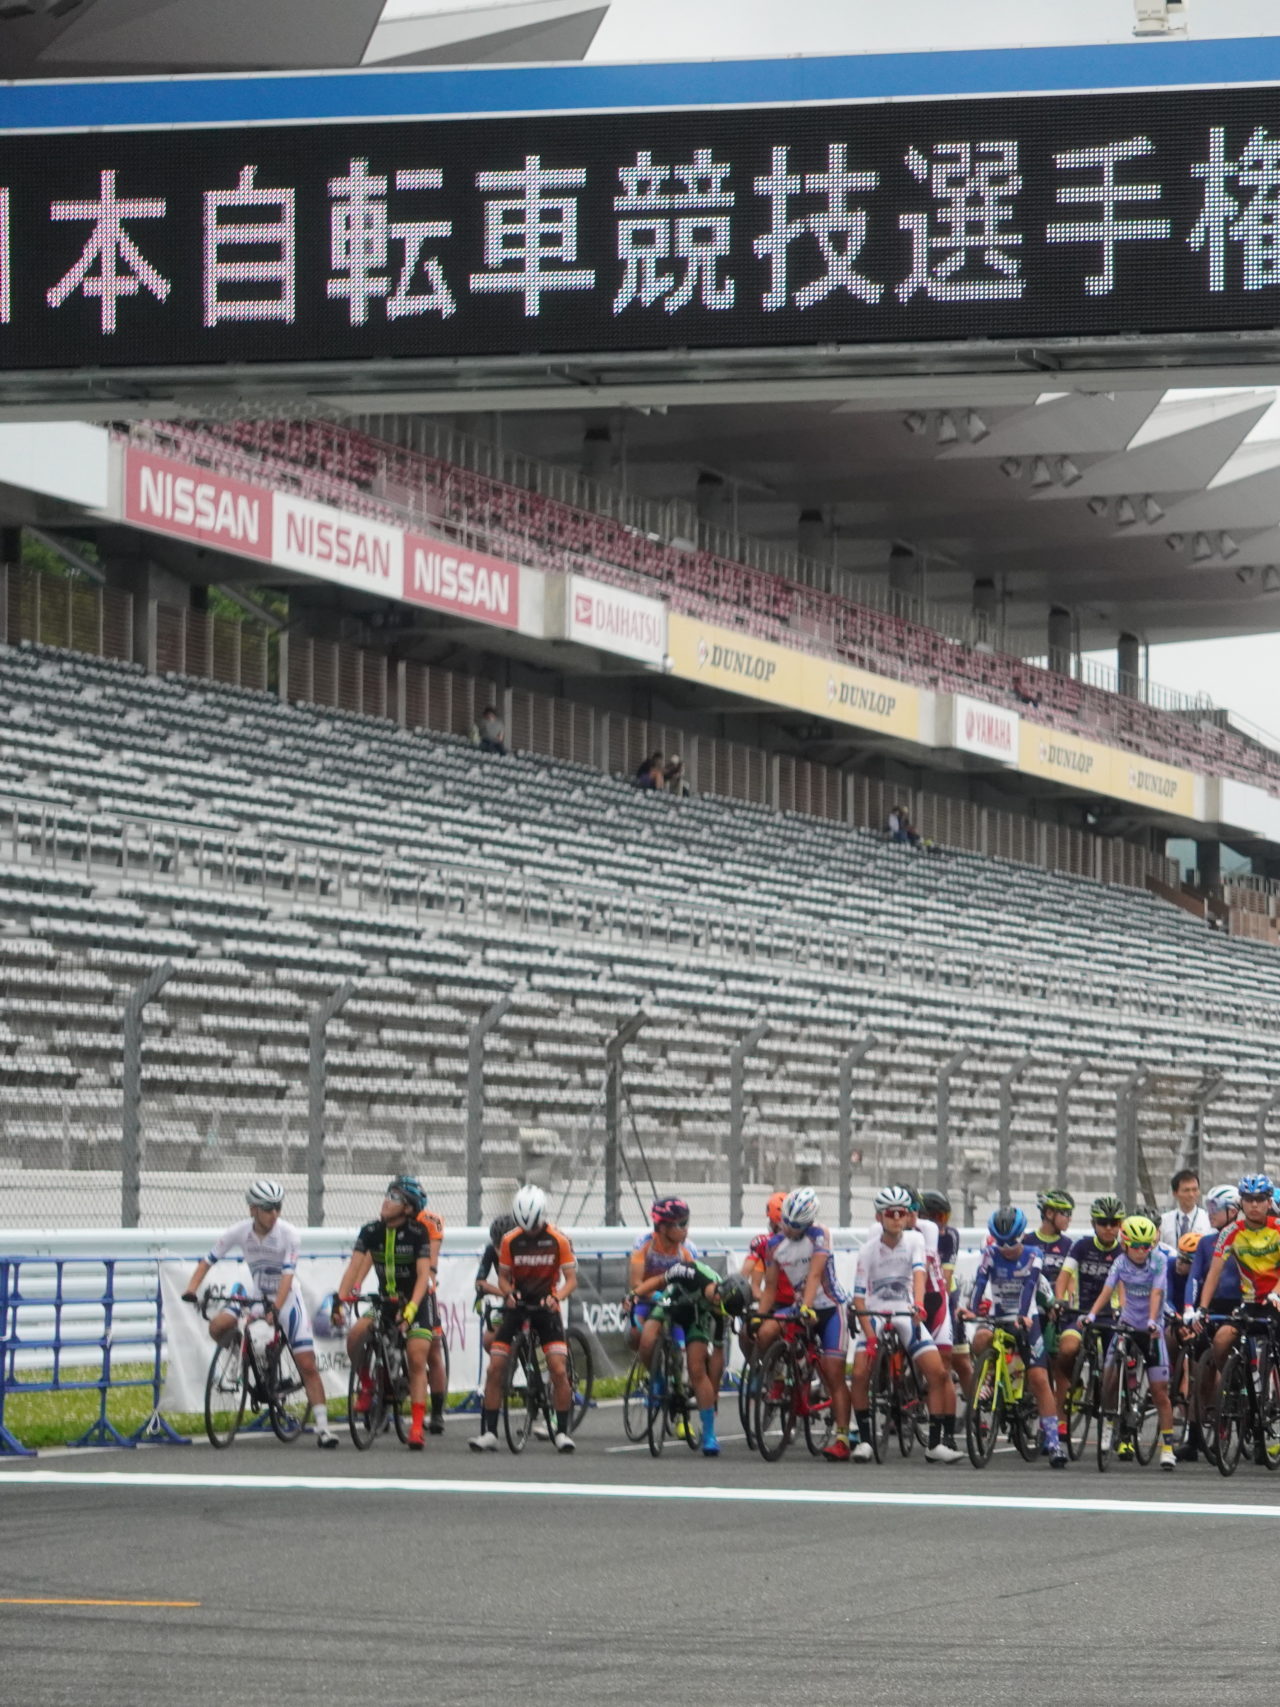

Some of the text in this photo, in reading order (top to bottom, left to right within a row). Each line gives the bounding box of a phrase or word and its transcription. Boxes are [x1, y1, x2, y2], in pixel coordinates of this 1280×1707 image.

[139, 465, 259, 545] NISSAN
[286, 515, 391, 580] NISSAN
[413, 548, 510, 615] NISSAN
[595, 607, 662, 648] DAIHATSU
[711, 644, 776, 683] DUNLOP
[839, 682, 896, 718] DUNLOP
[976, 711, 1012, 752] YAMAHA
[1047, 744, 1094, 776] DUNLOP
[1136, 770, 1178, 800] DUNLOP
